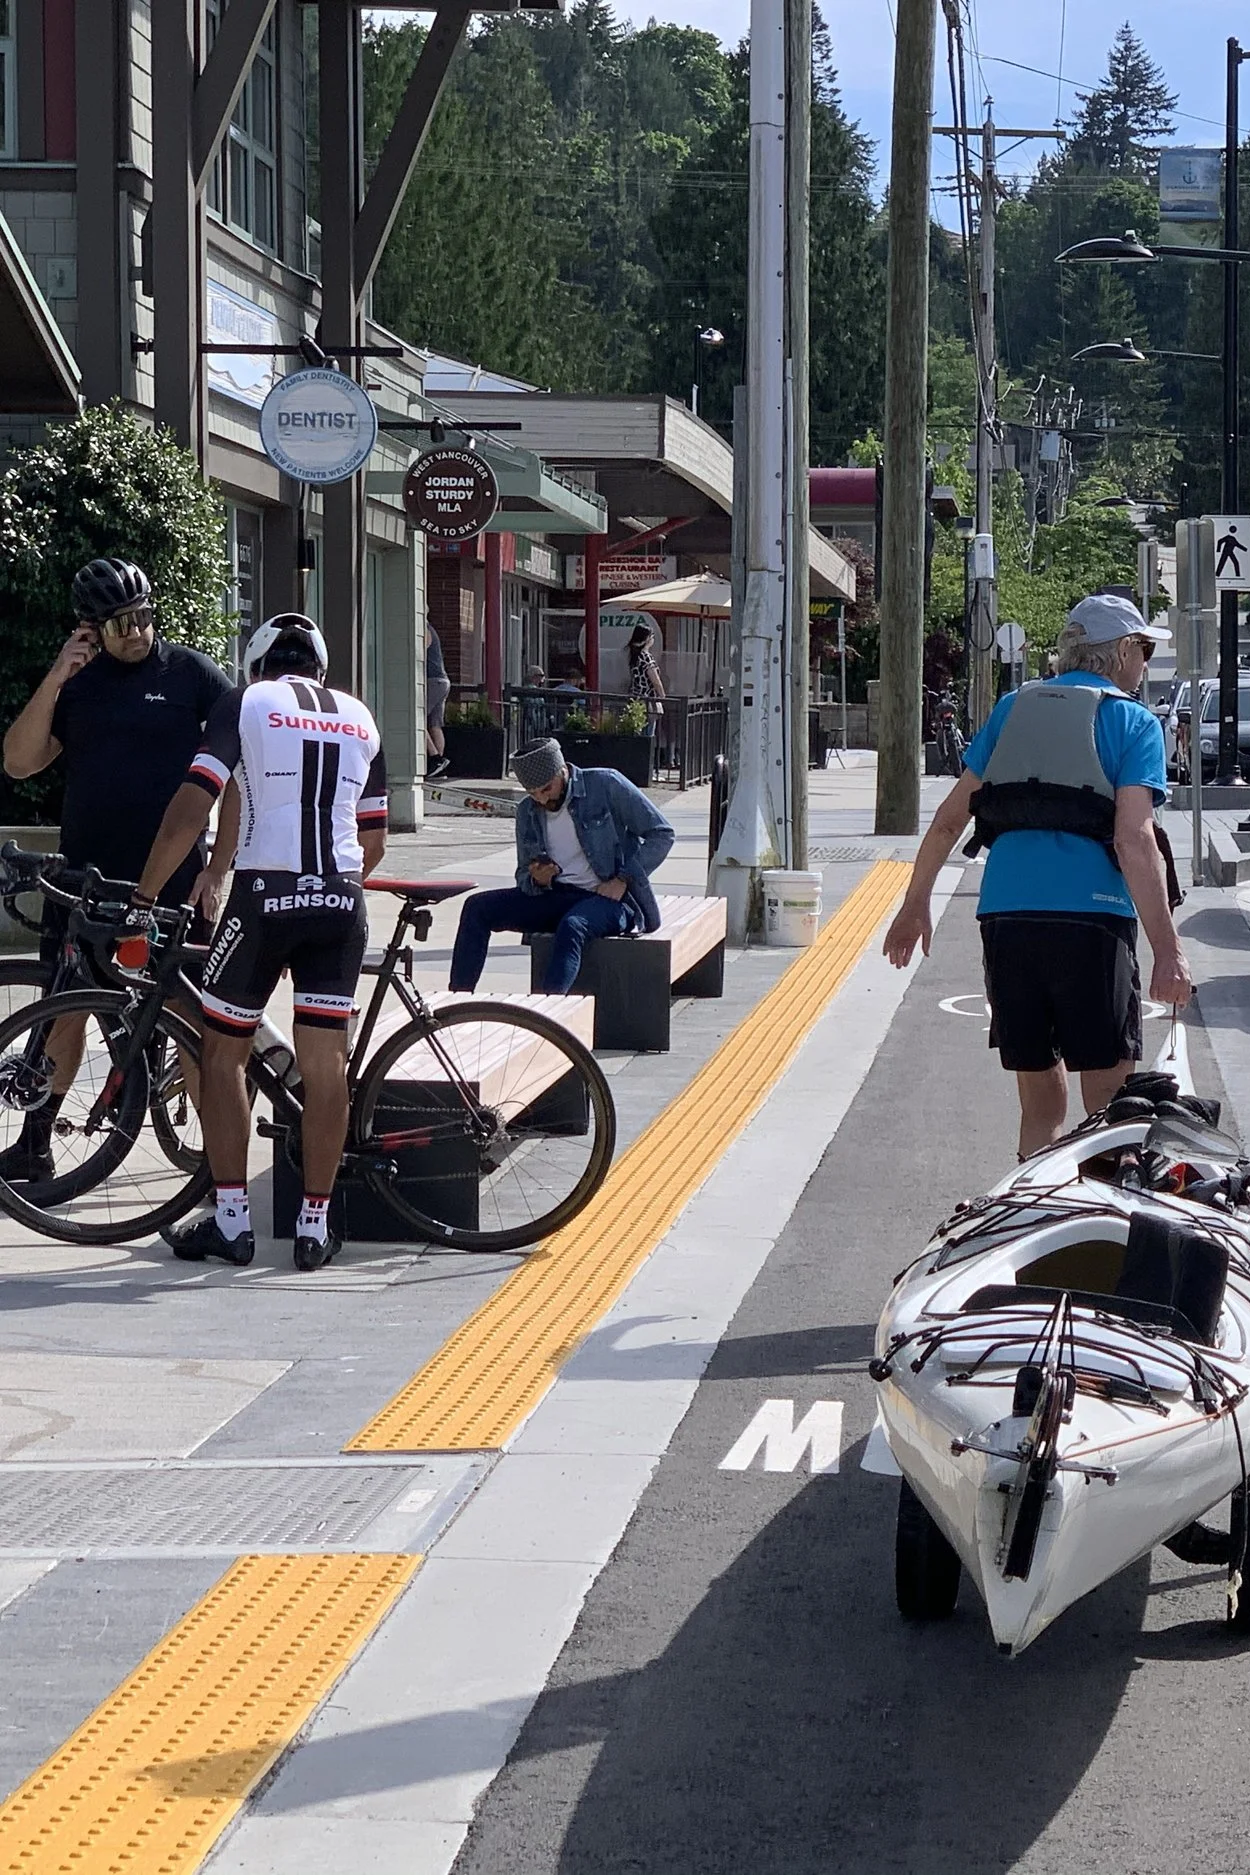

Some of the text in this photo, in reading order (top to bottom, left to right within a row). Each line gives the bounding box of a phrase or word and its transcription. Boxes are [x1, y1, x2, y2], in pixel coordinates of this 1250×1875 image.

[281, 372, 355, 392] FAMILY DENTISTRY
[277, 411, 357, 430] DENTIST
[271, 448, 364, 479] NEW PATIENTS WELCOME
[412, 451, 489, 480] WEST VANCOUVER
[425, 477, 474, 487] JORDAN
[425, 490, 474, 500] STURDY
[437, 502, 462, 513] MLA
[420, 518, 478, 536] SEA TO SKY
[810, 603, 835, 615] WAY
[600, 615, 650, 627] PIZZA
[268, 712, 369, 741] Sunweb
[263, 893, 355, 914] RENSON
[313, 998, 352, 1008] GIANT
[232, 1010, 261, 1019] GIAN
